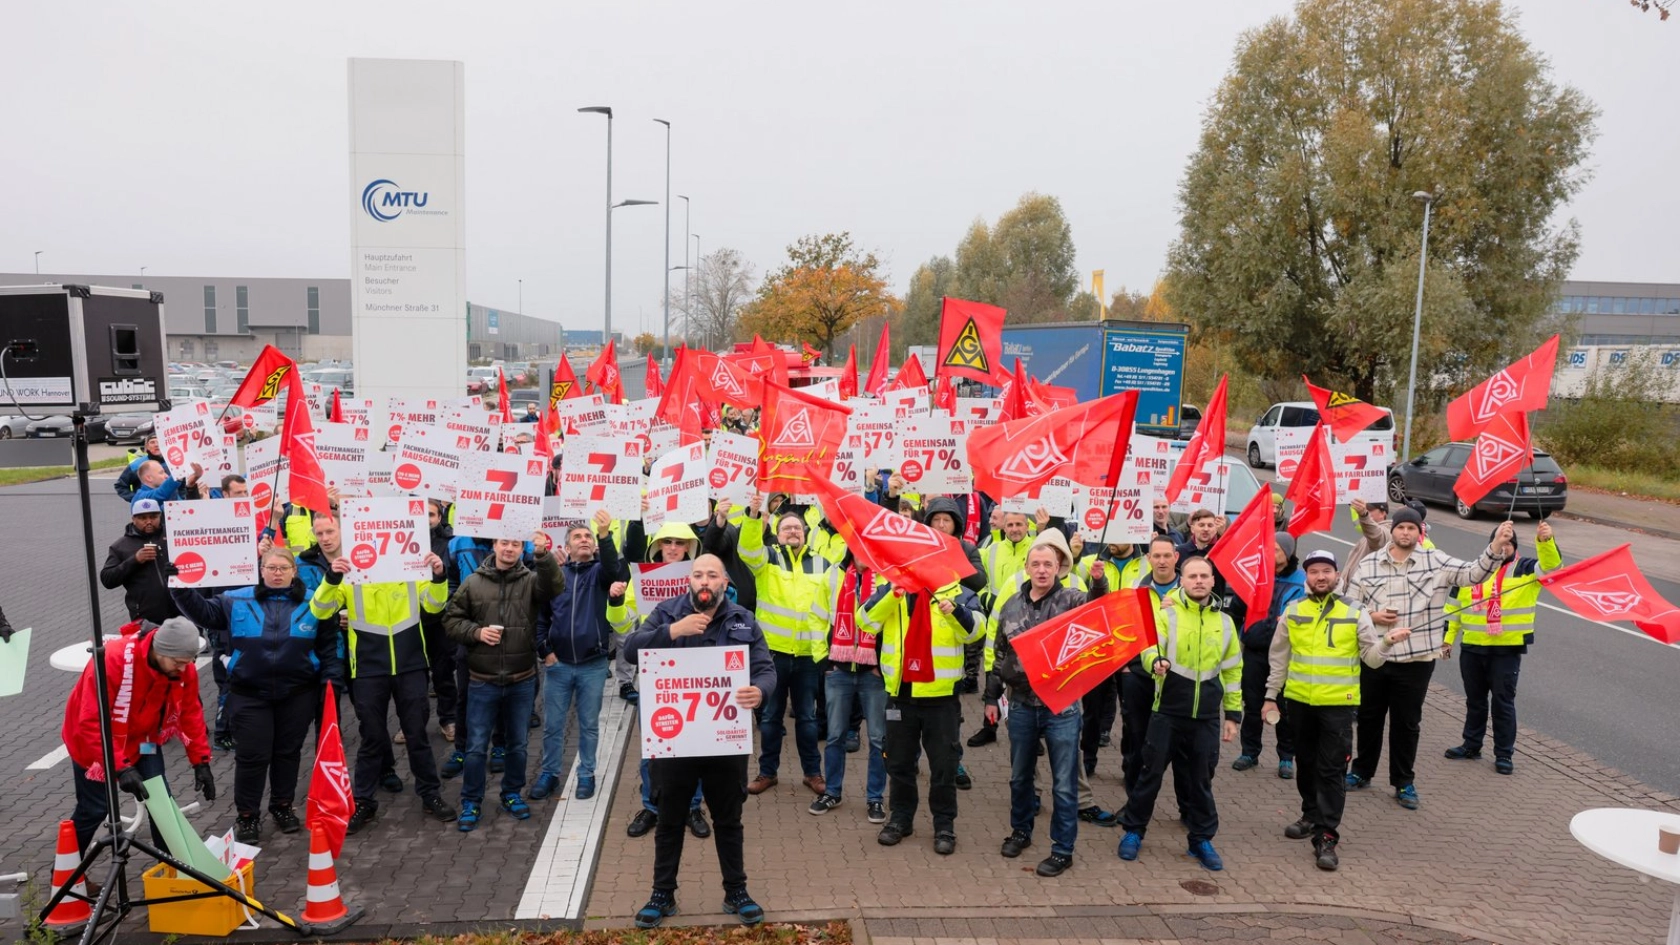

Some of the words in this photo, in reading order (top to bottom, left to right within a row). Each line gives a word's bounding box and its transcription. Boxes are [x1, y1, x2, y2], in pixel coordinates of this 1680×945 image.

[382, 192, 428, 207] MTU
[364, 254, 413, 262] Hauptzufahrt
[384, 264, 417, 272] Entrance
[365, 277, 399, 285] Besucher
[365, 287, 392, 295] Visitors
[365, 303, 402, 311] Münchner
[403, 304, 429, 312] Straße
[431, 304, 439, 312] 31
[1112, 343, 1154, 353] Babatz
[1570, 353, 1585, 364] IDS
[16, 388, 40, 397] WORK
[41, 388, 70, 397] Hannover
[408, 413, 435, 422] MEHR
[578, 410, 606, 423] MEHR
[163, 419, 204, 438] GEMEINSAM
[446, 421, 490, 434] GEMEINSAM
[856, 423, 893, 431] GEMEINSA
[165, 437, 177, 447] FÜR
[903, 439, 956, 448] GEMEINSAM
[316, 445, 365, 454] KRÄFTEMANGEL?!
[903, 449, 919, 458] FÜR
[317, 452, 364, 462] SGEMACHT!
[717, 449, 757, 466] GEMEINSA
[715, 458, 729, 468] FÜR
[1135, 457, 1167, 469] MEHR
[565, 473, 586, 483] ZUM
[587, 473, 639, 485] FAIRLIEBEN
[1345, 469, 1385, 479] FAIRLIEBEN
[661, 477, 705, 495] FAIRLIEBEN
[1190, 484, 1225, 494] FAIRLIEBEN
[460, 489, 482, 500] ZUM
[485, 491, 541, 506] FAIRLIEBEN
[1089, 498, 1105, 506] FÜR
[353, 520, 415, 531] GEMEINSAM
[173, 526, 250, 537] FACHKRÄFTEMANGEL?!
[354, 532, 373, 541] FÜR
[174, 534, 250, 547] HAUSGEMACHT!
[641, 575, 691, 587] SOLIDARITÄ
[641, 585, 691, 597] GEWINN
[655, 676, 731, 691] GEMEINSAM
[656, 691, 679, 704] FÜR
